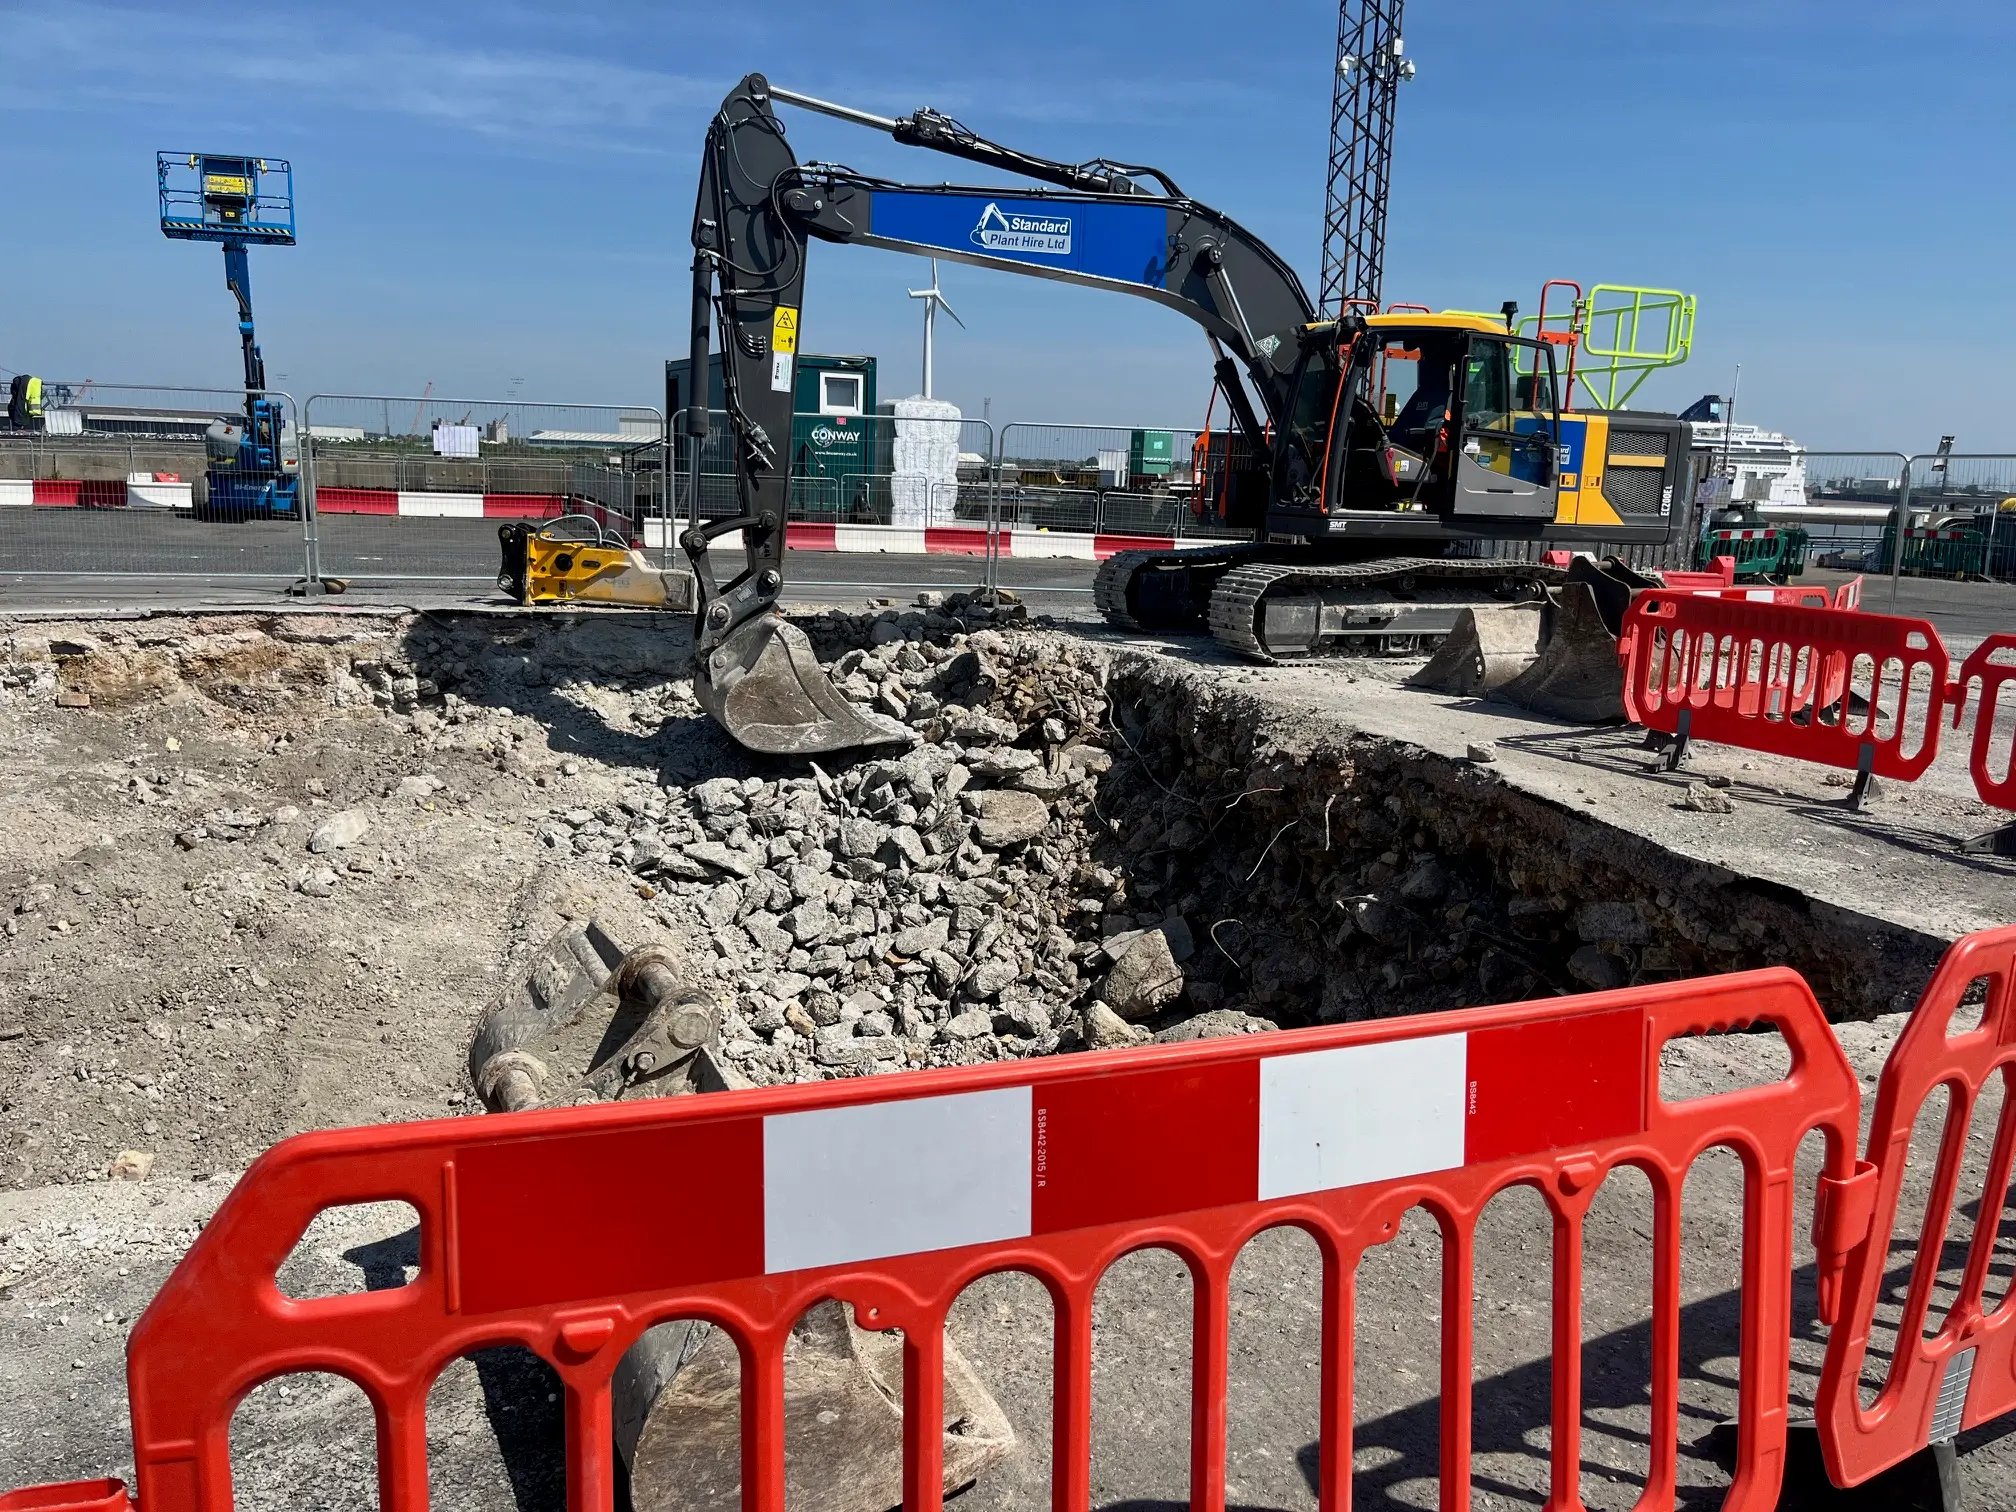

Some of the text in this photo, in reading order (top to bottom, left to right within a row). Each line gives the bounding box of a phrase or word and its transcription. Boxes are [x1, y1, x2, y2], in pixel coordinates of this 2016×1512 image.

[1011, 217, 1069, 234] Standard
[990, 234, 1066, 250] Plant Hire Ltd
[811, 427, 860, 442] CONWAY
[1660, 485, 1673, 516] EC200EL
[1469, 1080, 1477, 1115] BS8442
[1037, 1108, 1047, 1172] BS8442-2015
[1037, 1180, 1046, 1188] R
